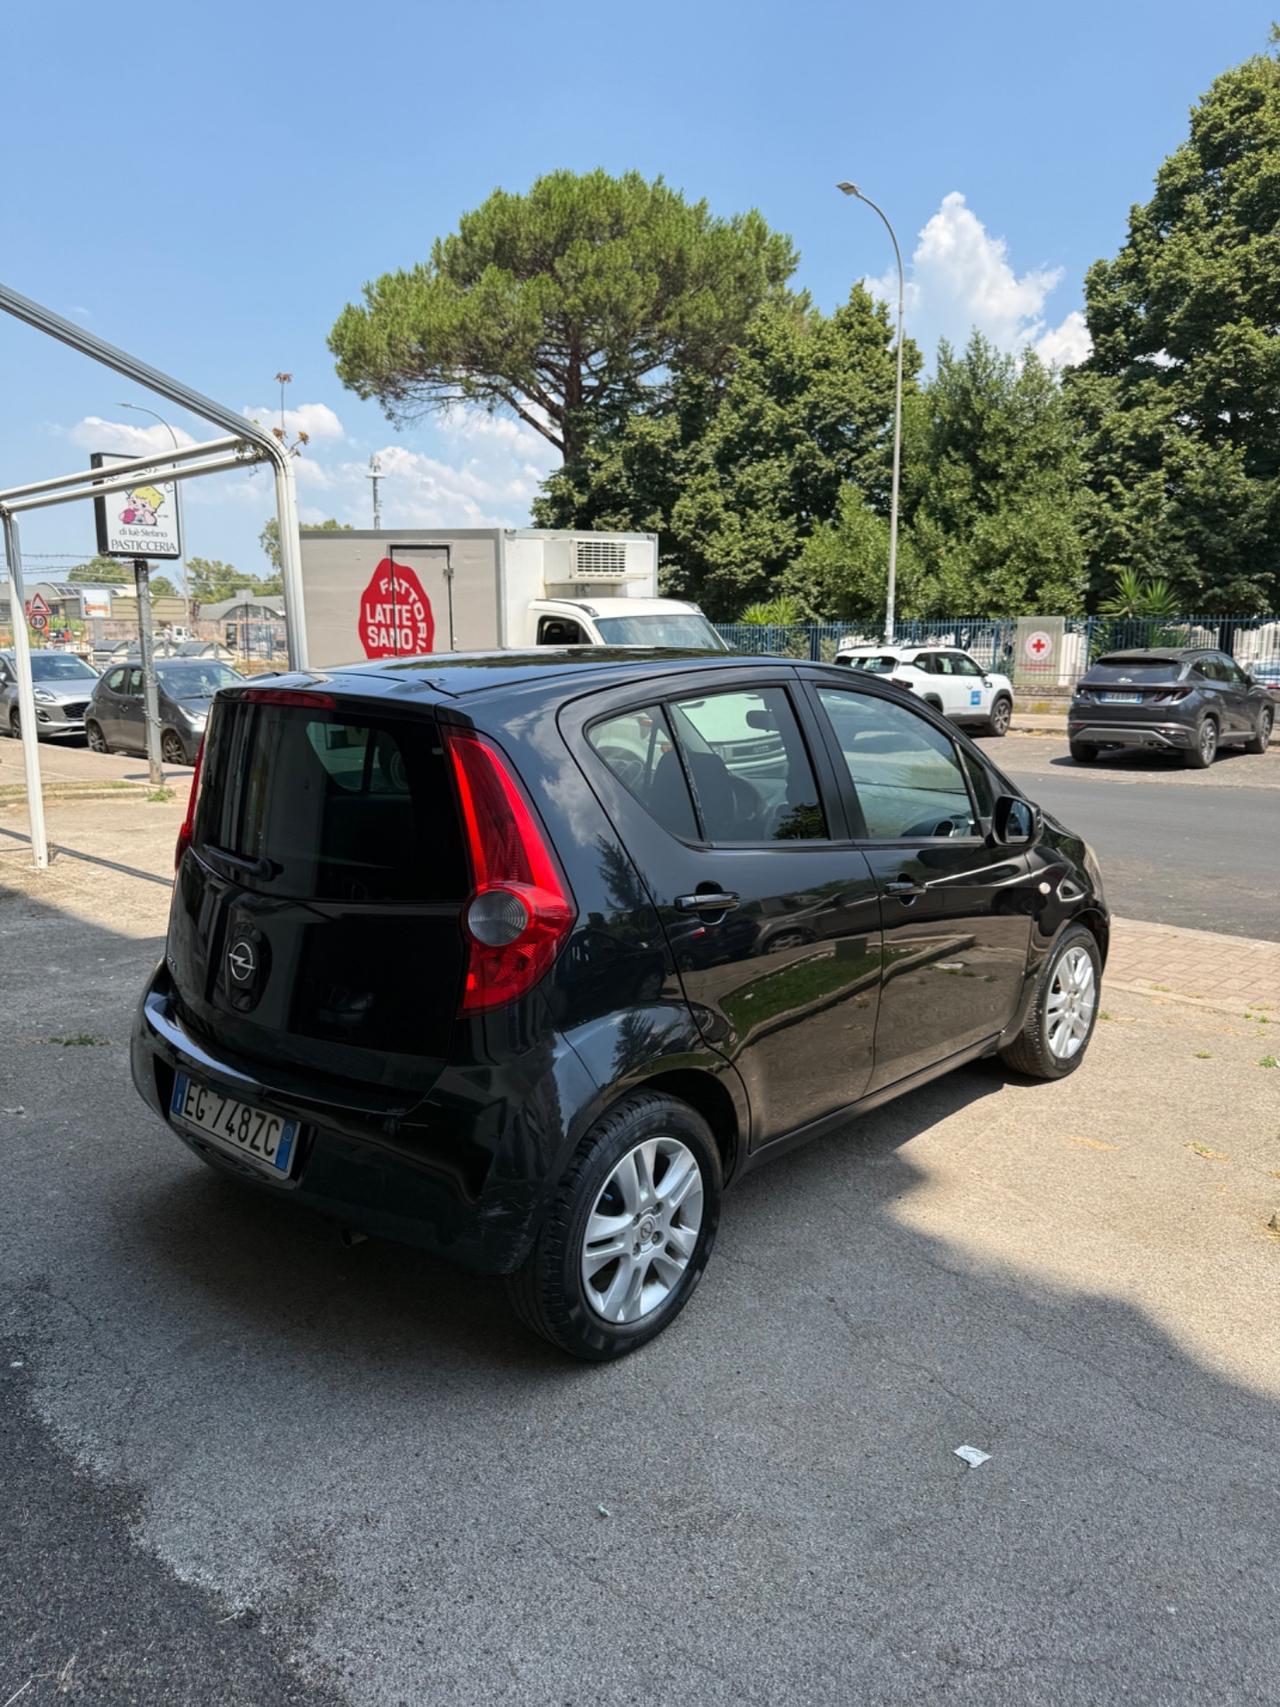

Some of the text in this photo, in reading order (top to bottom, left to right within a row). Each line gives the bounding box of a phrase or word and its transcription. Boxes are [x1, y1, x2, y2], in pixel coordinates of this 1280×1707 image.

[119, 528, 128, 536] di
[140, 529, 168, 538] Stefano
[111, 539, 177, 552] PASTICCERIA
[365, 603, 412, 626] LATTE
[367, 625, 414, 650] SANO
